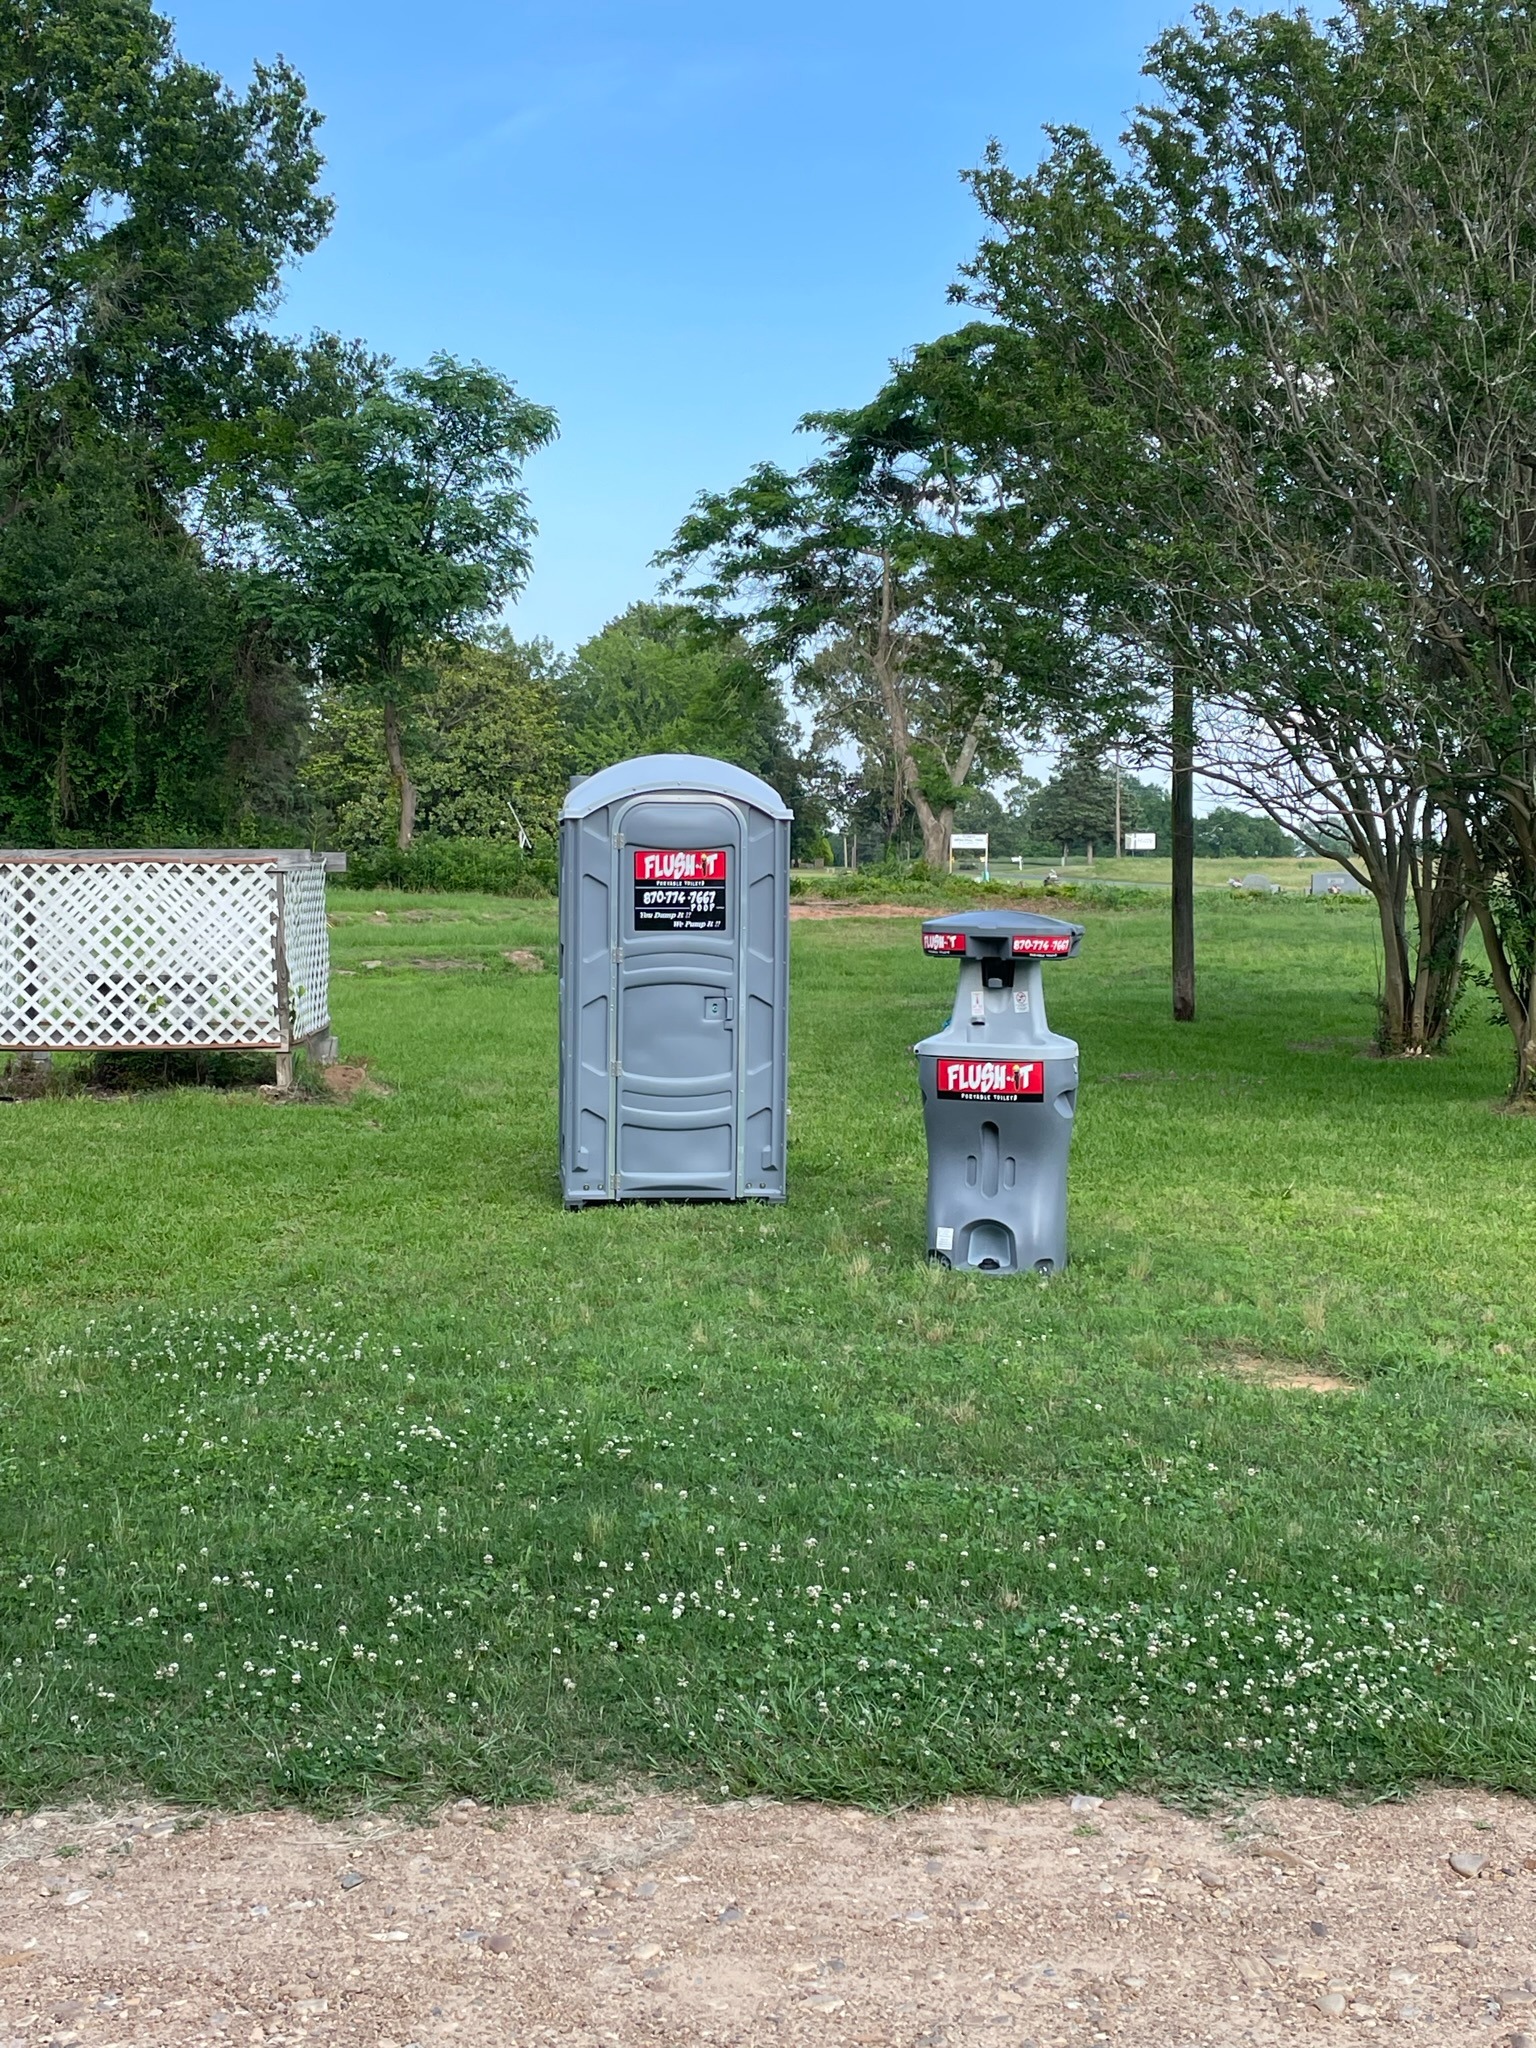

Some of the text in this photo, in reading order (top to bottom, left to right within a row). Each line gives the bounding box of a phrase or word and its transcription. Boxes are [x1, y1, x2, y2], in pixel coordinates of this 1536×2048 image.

[654, 911, 676, 920] Dump
[685, 920, 706, 929] Pump
[961, 1093, 991, 1101] PORTABLE
